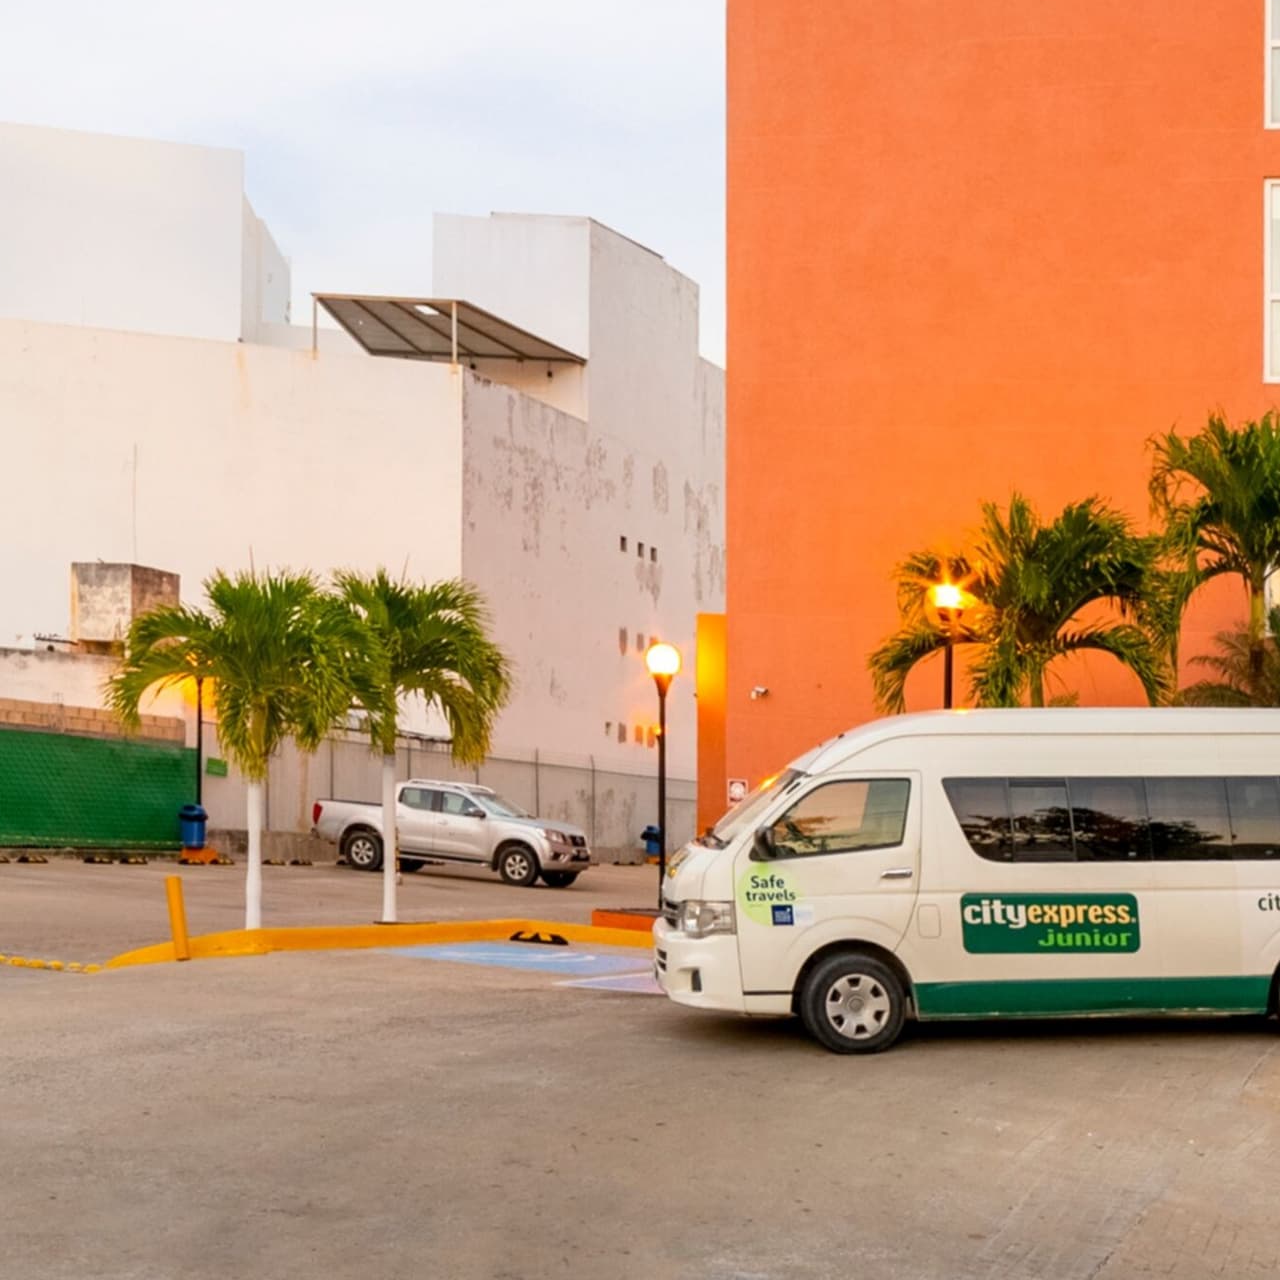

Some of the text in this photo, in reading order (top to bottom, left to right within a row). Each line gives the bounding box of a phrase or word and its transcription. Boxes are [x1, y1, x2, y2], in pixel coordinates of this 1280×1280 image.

[750, 874, 785, 889] Safe
[746, 889, 796, 902] travels
[1038, 928, 1132, 947] junior
